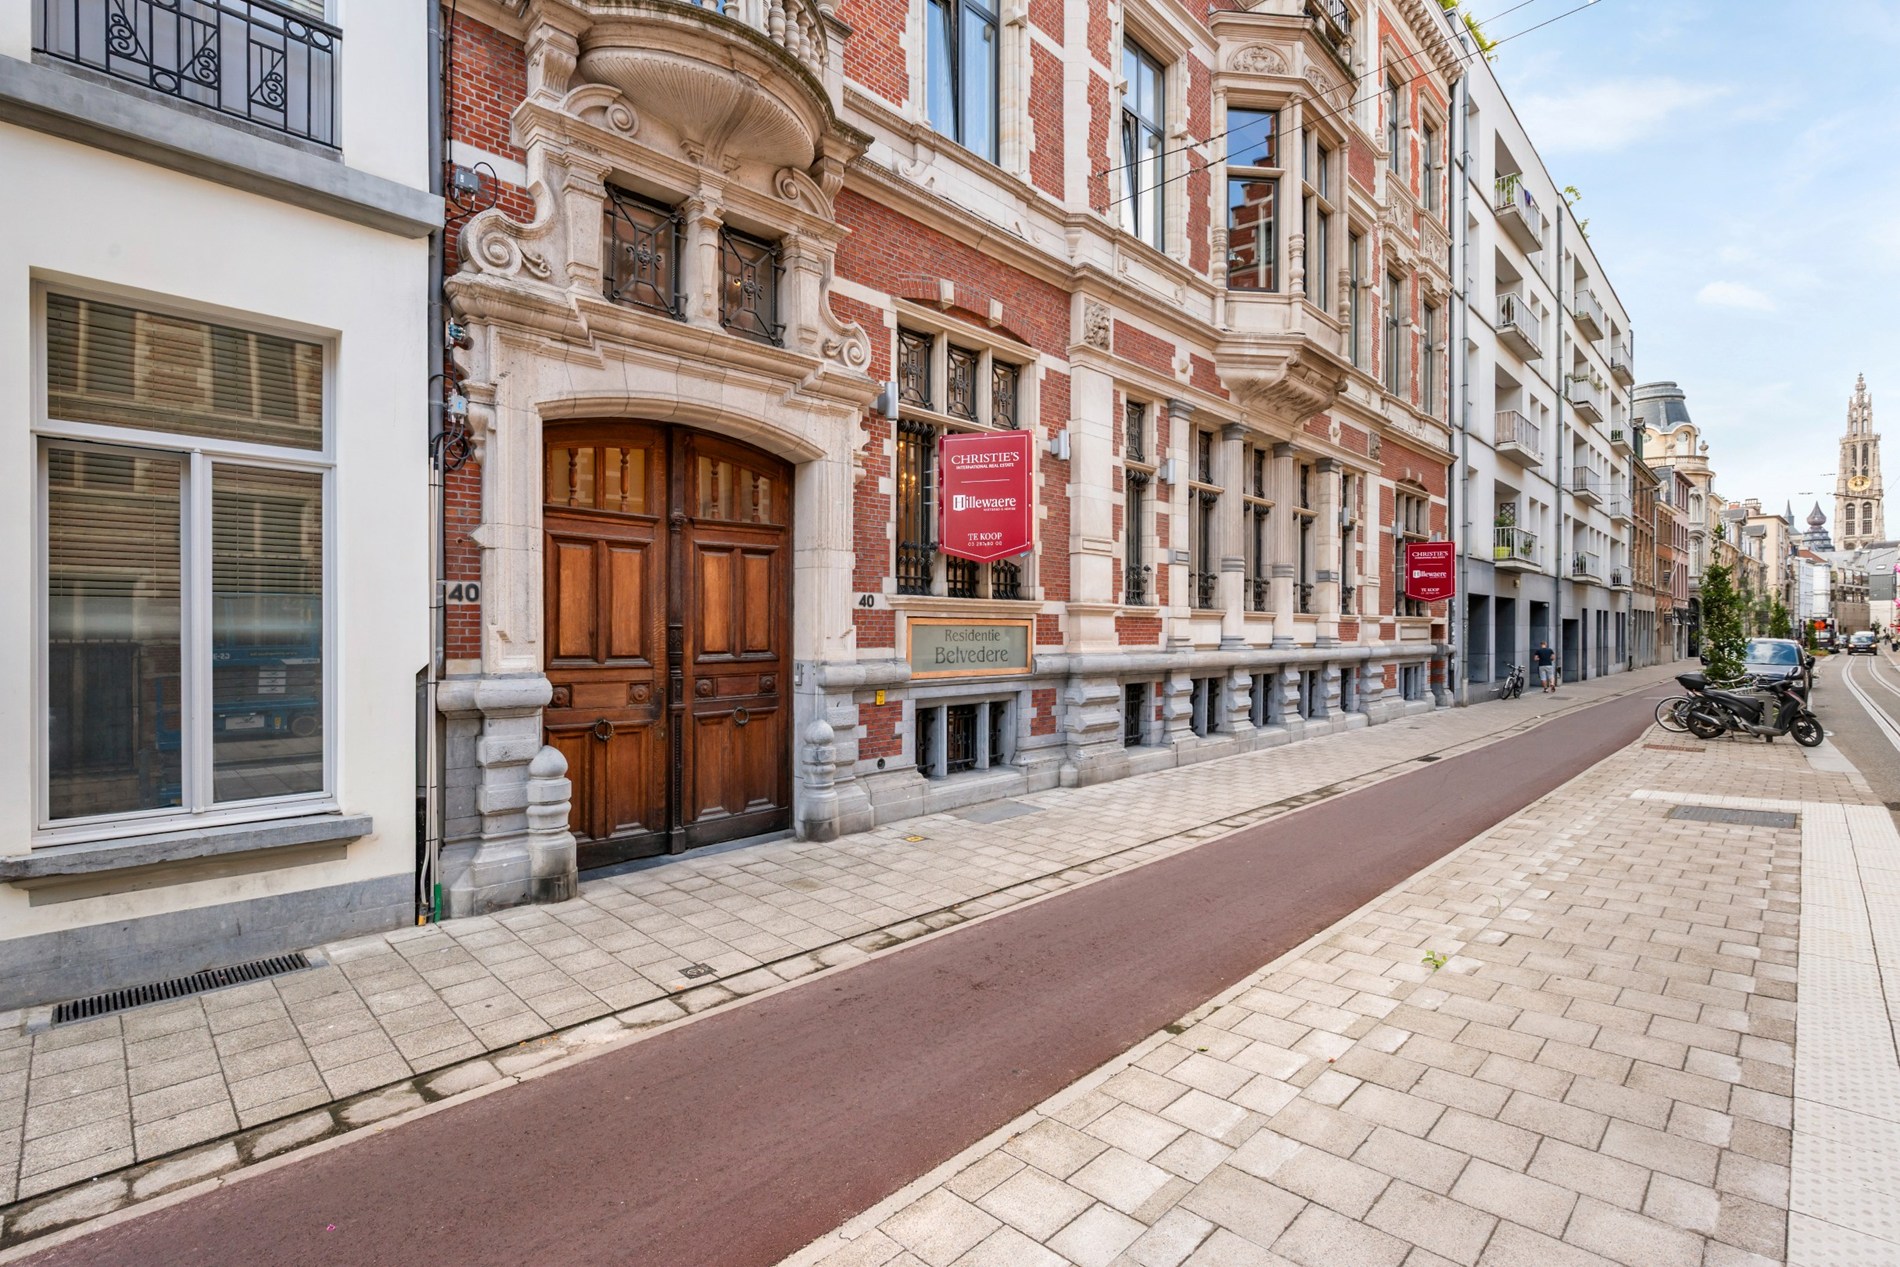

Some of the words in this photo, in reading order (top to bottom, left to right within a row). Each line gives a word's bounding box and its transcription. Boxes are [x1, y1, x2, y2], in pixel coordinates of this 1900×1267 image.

[951, 451, 1020, 465] CHRISTIE'S
[967, 533, 978, 541] TE
[980, 532, 1003, 540] KOOP
[448, 583, 480, 602] 40
[859, 594, 875, 608] 40
[944, 629, 1001, 642] Residentie
[935, 646, 1009, 665] Belvedere
